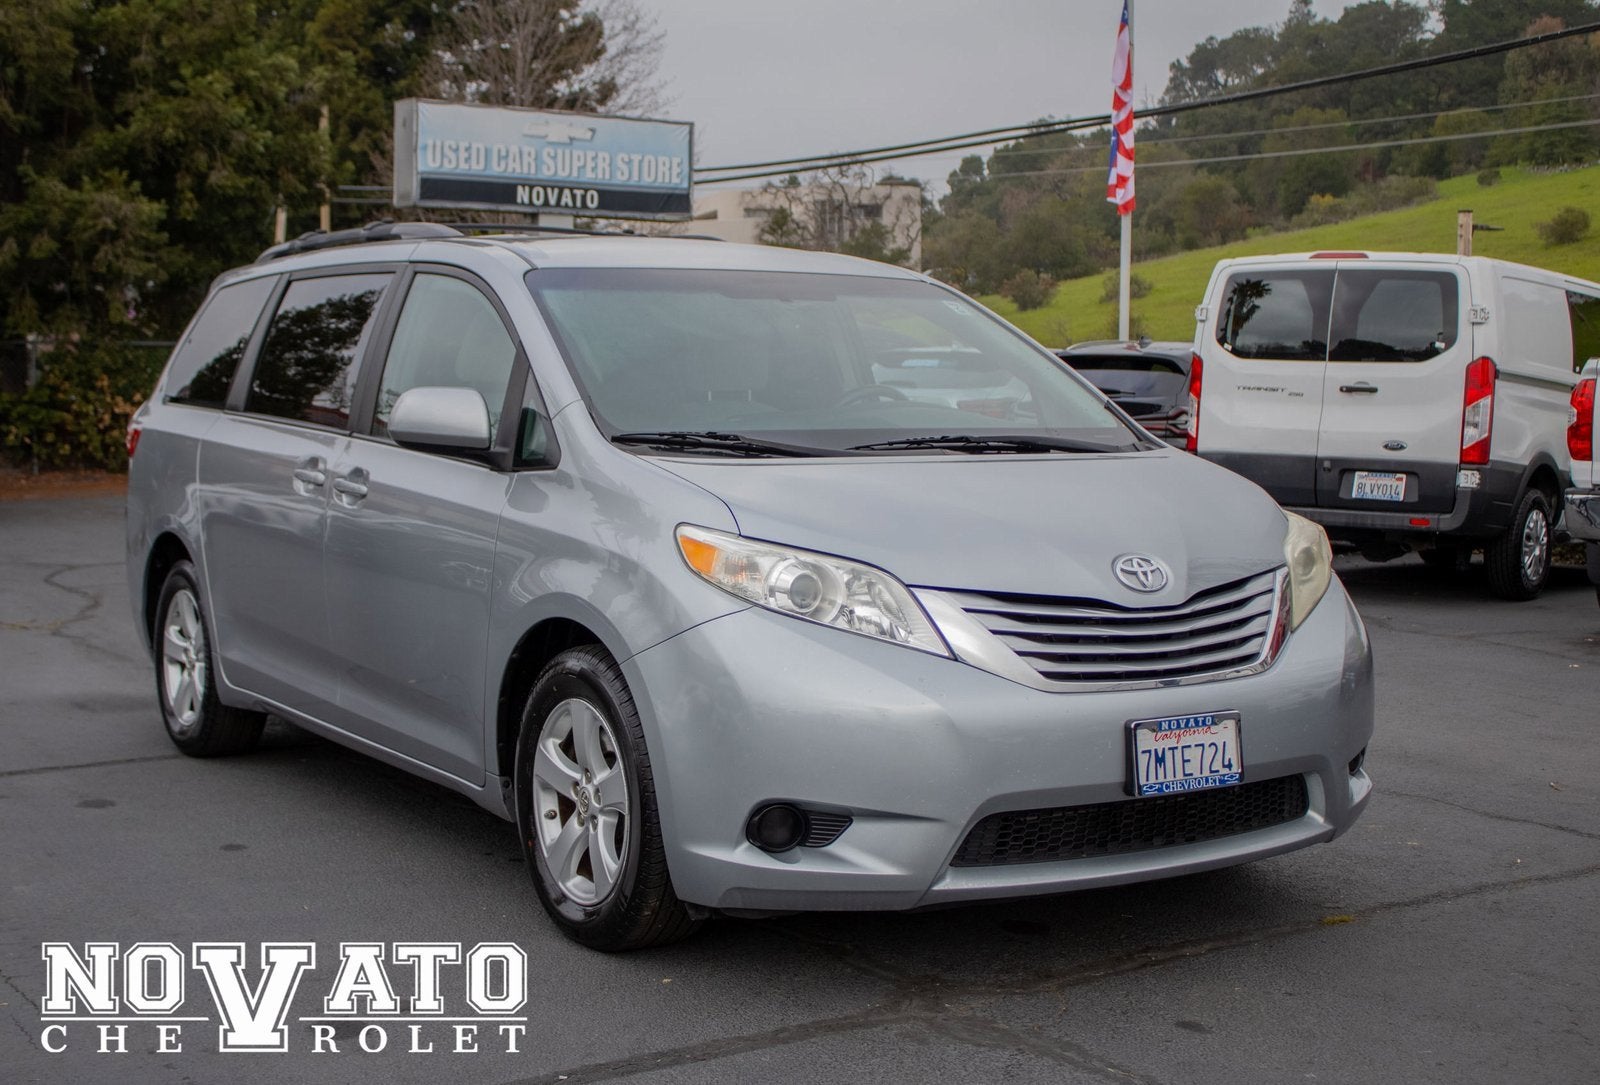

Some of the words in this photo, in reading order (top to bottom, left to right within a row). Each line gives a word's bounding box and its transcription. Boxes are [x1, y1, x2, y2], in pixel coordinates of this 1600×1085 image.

[426, 138, 486, 171] USED
[491, 144, 537, 174] CAR
[542, 148, 611, 180] SUPER
[616, 152, 682, 184] STORE
[516, 185, 599, 208] NOVATO
[1161, 716, 1213, 731] NOVATO
[1154, 726, 1218, 744] California
[1141, 741, 1233, 782] 7MTE724
[1163, 776, 1221, 792] CHEVROLET
